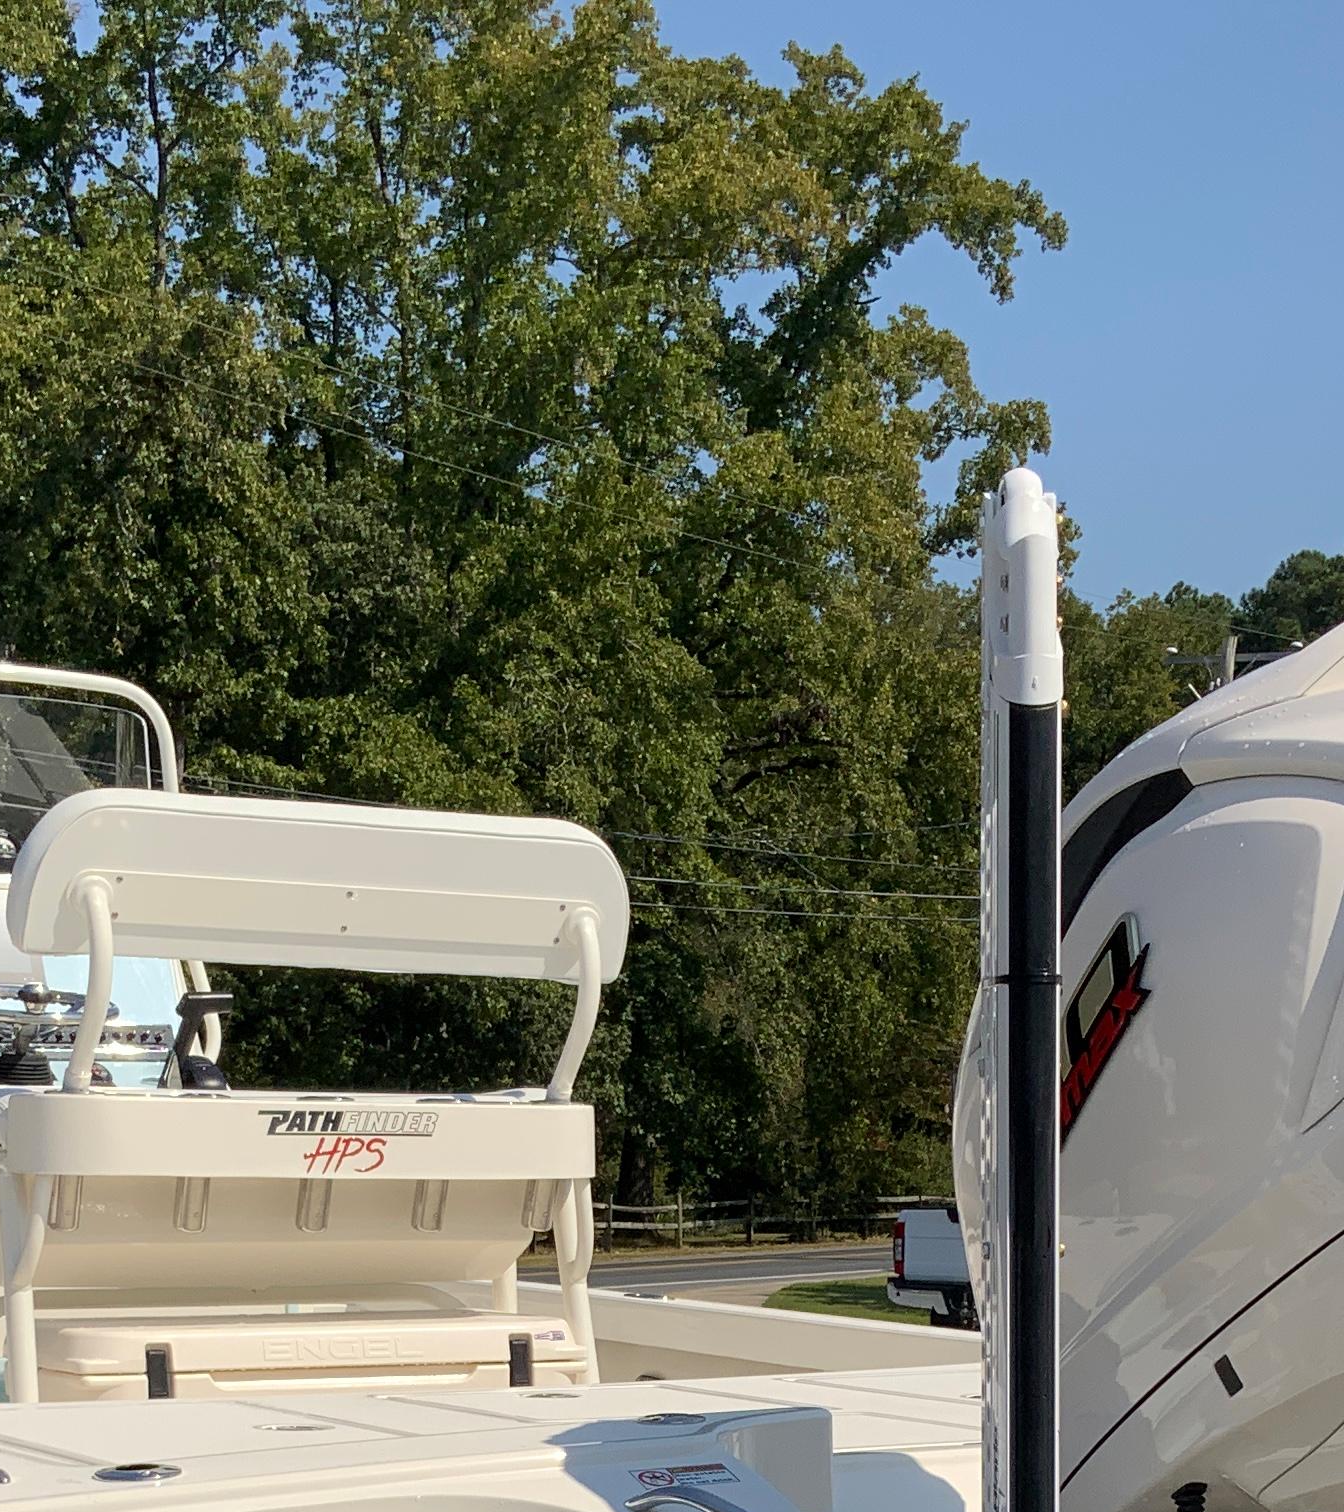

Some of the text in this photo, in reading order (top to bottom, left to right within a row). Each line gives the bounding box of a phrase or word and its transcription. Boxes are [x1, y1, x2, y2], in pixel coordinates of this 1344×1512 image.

[258, 1110, 440, 1136] PATHFINDER
[303, 1136, 388, 1176] HPS
[262, 1336, 423, 1362] ENGEL
